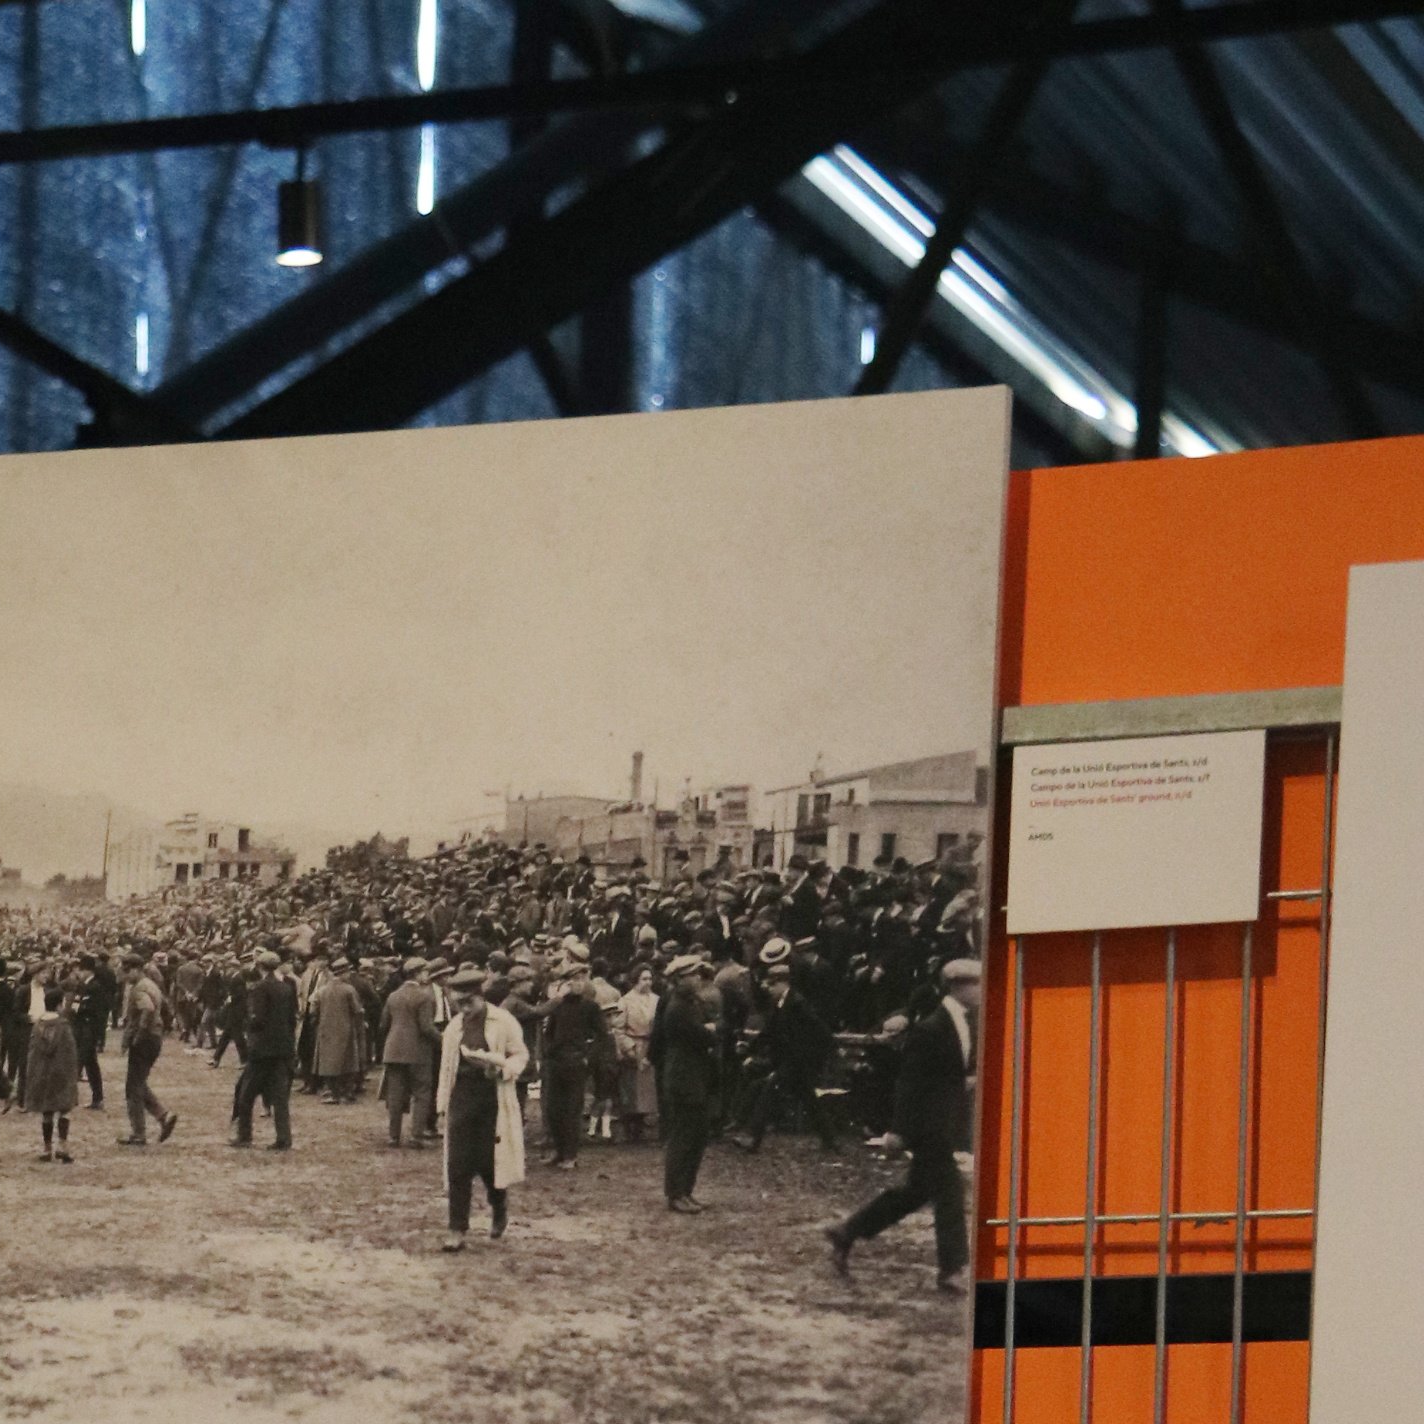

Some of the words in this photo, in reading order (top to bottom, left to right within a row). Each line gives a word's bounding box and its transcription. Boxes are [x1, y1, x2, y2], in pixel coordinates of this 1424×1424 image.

[1031, 768, 1057, 776] Camp
[1059, 766, 1071, 775] de
[1072, 765, 1081, 773] la
[1083, 763, 1104, 773] Unió
[1106, 762, 1148, 772] Esportiva
[1150, 761, 1161, 769] de
[1030, 784, 1063, 792] Campo
[1064, 782, 1076, 790] de
[1078, 781, 1085, 789] la
[1111, 777, 1153, 788] Esportiva
